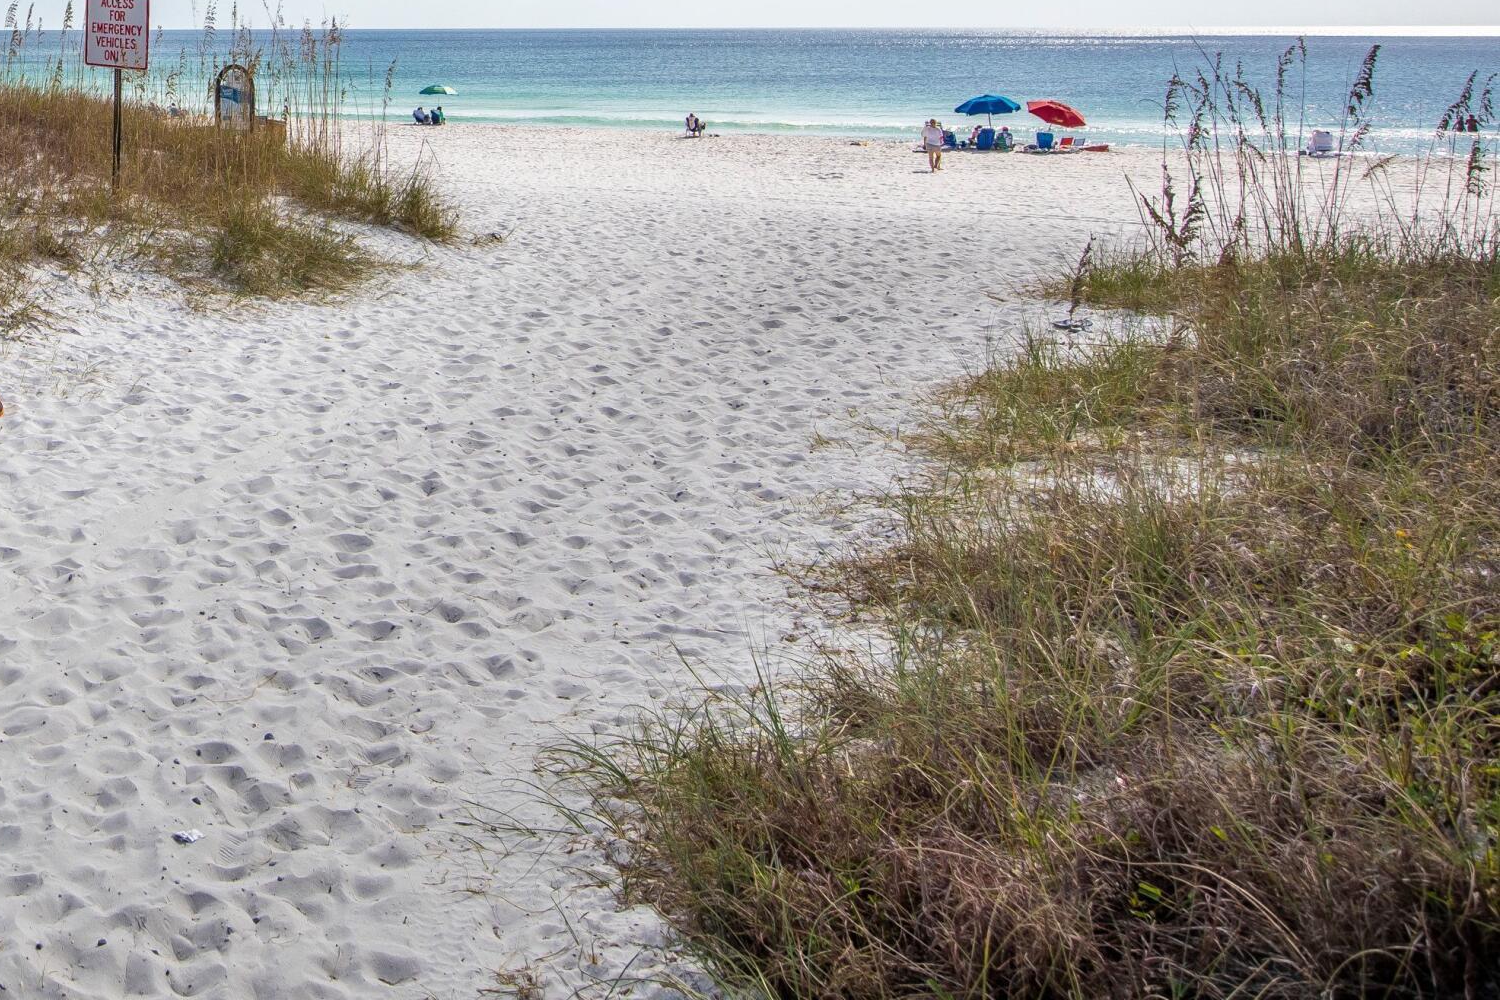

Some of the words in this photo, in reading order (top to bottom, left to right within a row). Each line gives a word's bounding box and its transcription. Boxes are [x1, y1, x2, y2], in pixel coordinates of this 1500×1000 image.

[110, 10, 125, 21] FOR
[91, 22, 142, 36] EMERGENCY
[96, 36, 136, 49] VEHICLES
